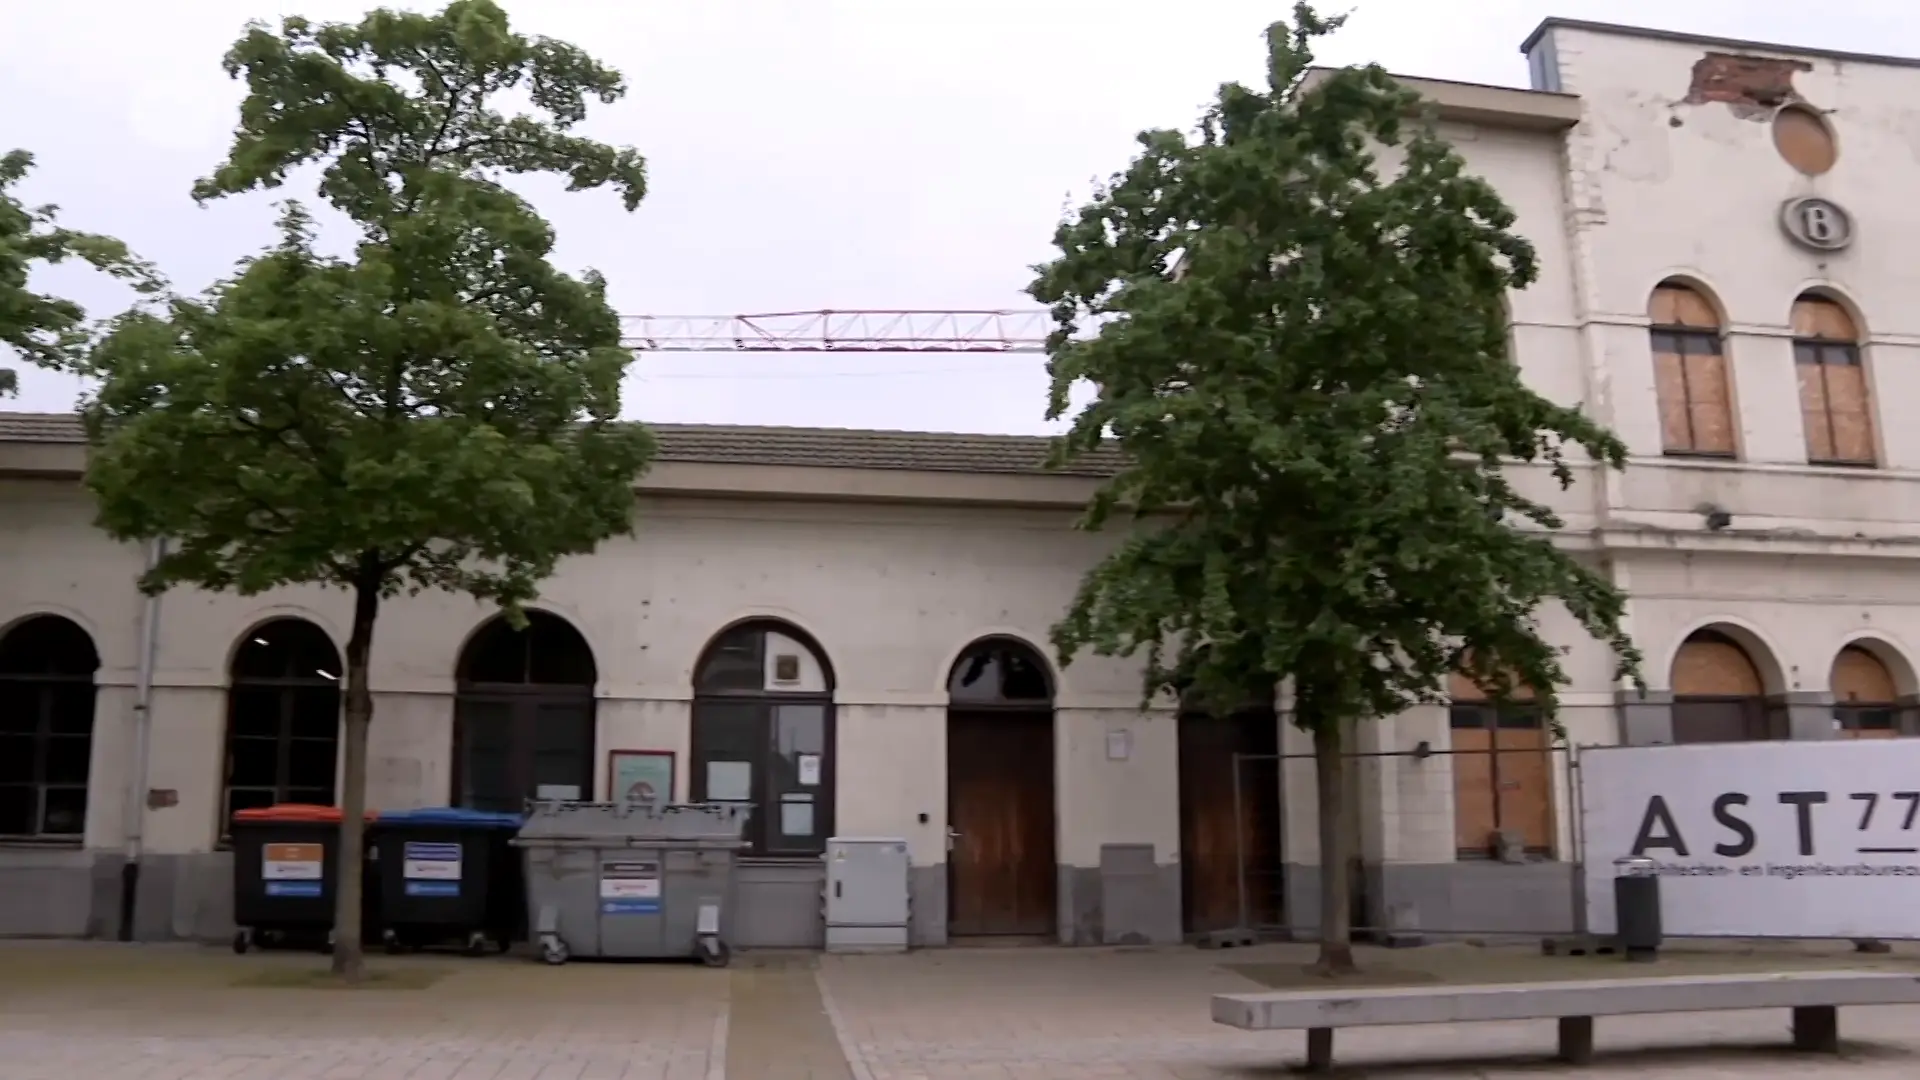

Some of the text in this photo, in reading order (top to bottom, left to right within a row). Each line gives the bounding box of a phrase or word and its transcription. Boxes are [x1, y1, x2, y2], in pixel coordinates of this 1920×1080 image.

[1807, 207, 1832, 240] B
[1631, 791, 1920, 857] AST 77
[1740, 865, 1763, 877] en
[1767, 862, 1920, 880] ingenieursburea
